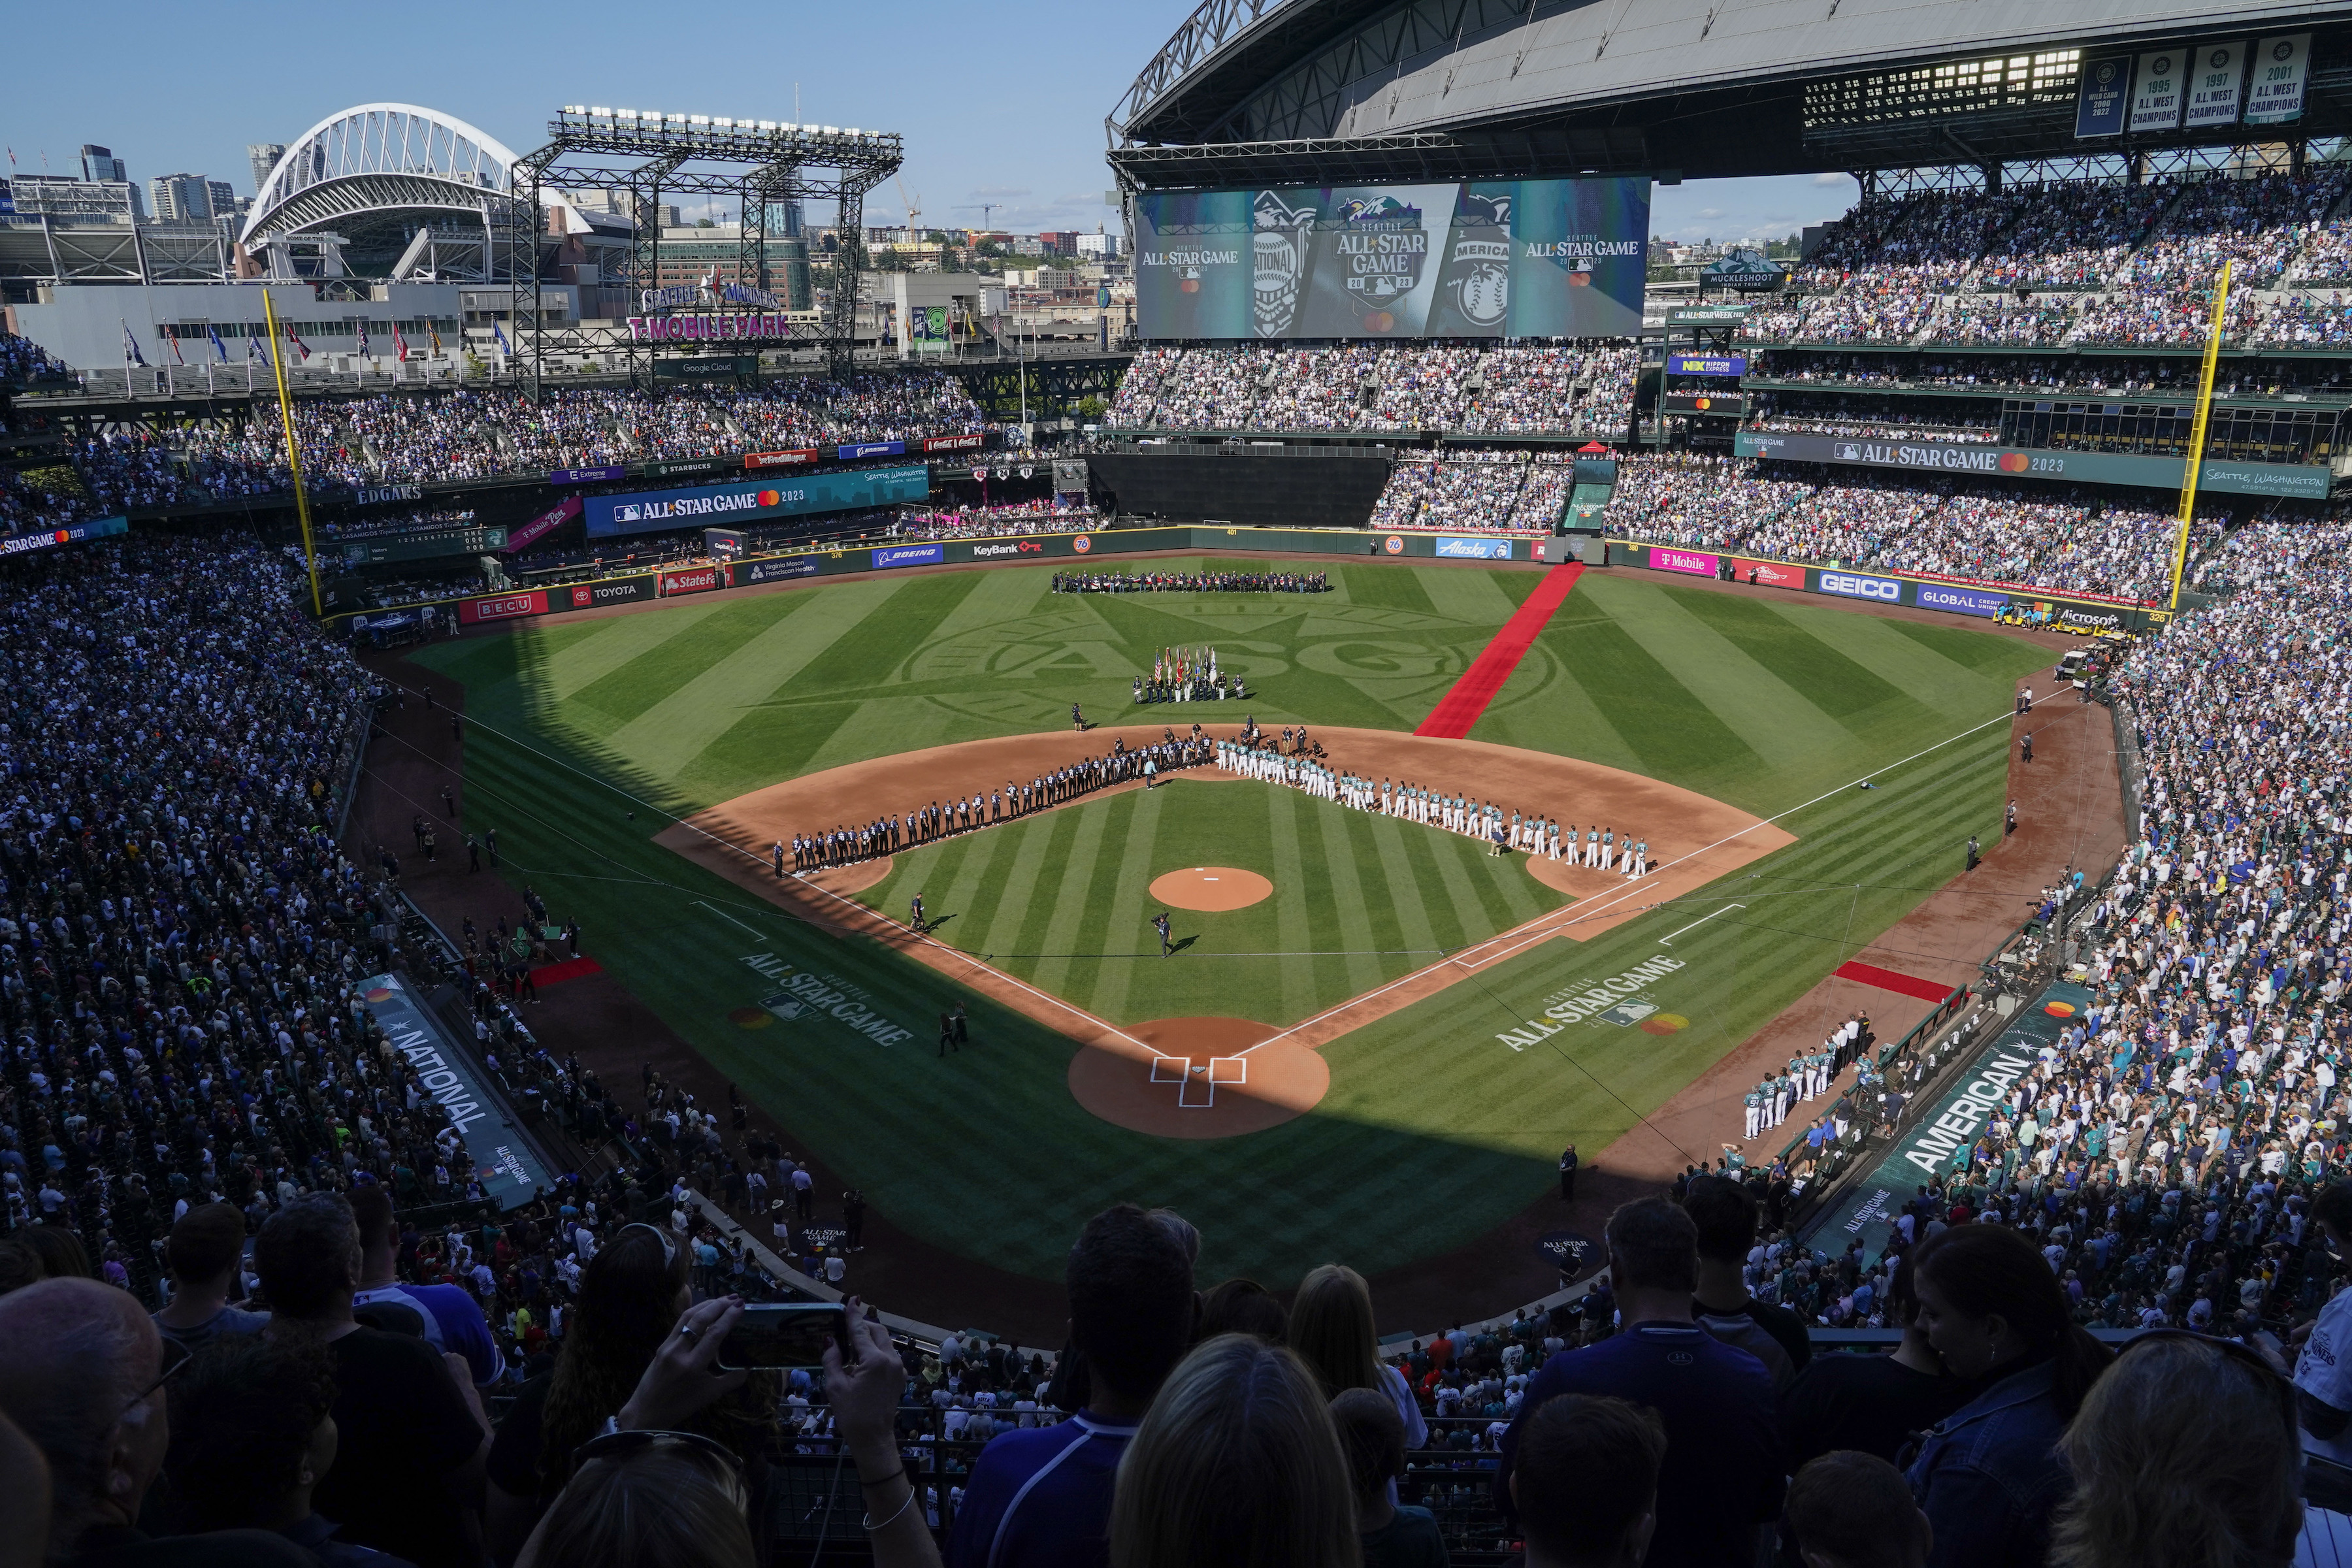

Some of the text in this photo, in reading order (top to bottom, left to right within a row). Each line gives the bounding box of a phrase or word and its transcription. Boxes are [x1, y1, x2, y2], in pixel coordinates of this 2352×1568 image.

[2206, 73, 2229, 88] 1997
[2266, 65, 2293, 81] 2001
[2148, 79, 2170, 93] 1995
[2257, 82, 2297, 97] A.L. WEST
[2093, 100, 2111, 108] 2000
[2138, 95, 2175, 109] A.L. WEST
[2195, 90, 2233, 103] A.L. WEST
[2092, 108, 2110, 116] 2022
[2189, 104, 2236, 119] CHAMPIONS
[2249, 97, 2299, 113] CHAMPIONS
[2132, 110, 2177, 124] CHAMPIONS
[2269, 114, 2285, 123] WINS
[1362, 223, 1401, 232] SEATTLE
[1337, 233, 1426, 255] ALL STAR
[1526, 241, 1639, 257] ALL STAR GAME
[1142, 250, 1238, 265] ALL STAR GAME
[1352, 254, 1409, 274] GAME
[1710, 274, 1774, 282] MUCKLESHOOT
[644, 284, 781, 312] SEATTLE MARINERS
[1698, 311, 1714, 319] STAR
[1713, 310, 1733, 319] WEEK
[626, 314, 791, 340] T-MOBILE PARK
[683, 363, 732, 374] Google Cloud
[1862, 444, 2064, 472] ALL STAR GAME 2023
[580, 470, 606, 479] Extreme
[670, 463, 711, 472] STARBUCKS
[357, 486, 423, 505] EDGARS
[714, 493, 757, 512] GAME
[781, 489, 805, 502] 2023
[342, 530, 378, 540] CASAMIGOS
[408, 523, 443, 532] CASAMIGOS
[529, 521, 549, 536] Mobile
[4, 540, 29, 553] STAR
[27, 532, 56, 549] GAME
[69, 529, 85, 539] 2023
[1075, 538, 1088, 549] 76
[1388, 540, 1401, 549] 76
[1439, 540, 1487, 556] Alaska
[892, 549, 936, 559] BOEING
[973, 544, 1019, 556] KeyBank
[764, 559, 805, 573] Virginia Mason
[1671, 553, 1706, 570] Mobile
[765, 564, 815, 577] Franciscan Health
[594, 585, 637, 598] TOYOTA
[1820, 573, 1899, 600] GEICO
[482, 598, 528, 615] BECU
[1923, 591, 1976, 608] GLOBAL
[326, 620, 335, 629] 331
[2148, 612, 2166, 623] 326
[821, 973, 872, 1000] SEATTLE
[1542, 977, 1597, 1005] SEATTLE
[1544, 988, 1625, 1024] STAR
[1603, 954, 1687, 993] GAME
[738, 952, 914, 1047] ALL STAR GAME
[1585, 991, 1656, 1029] 20 23
[393, 1029, 487, 1135] NATIONAL
[1904, 1055, 2031, 1175] AMERICAN
[495, 1145, 511, 1158] ALL
[502, 1154, 520, 1170] STAR
[512, 1166, 532, 1185] GAME
[1844, 1219, 1864, 1233] ALL
[1854, 1205, 1877, 1222] STAR
[1867, 1188, 1891, 1207] GAME
